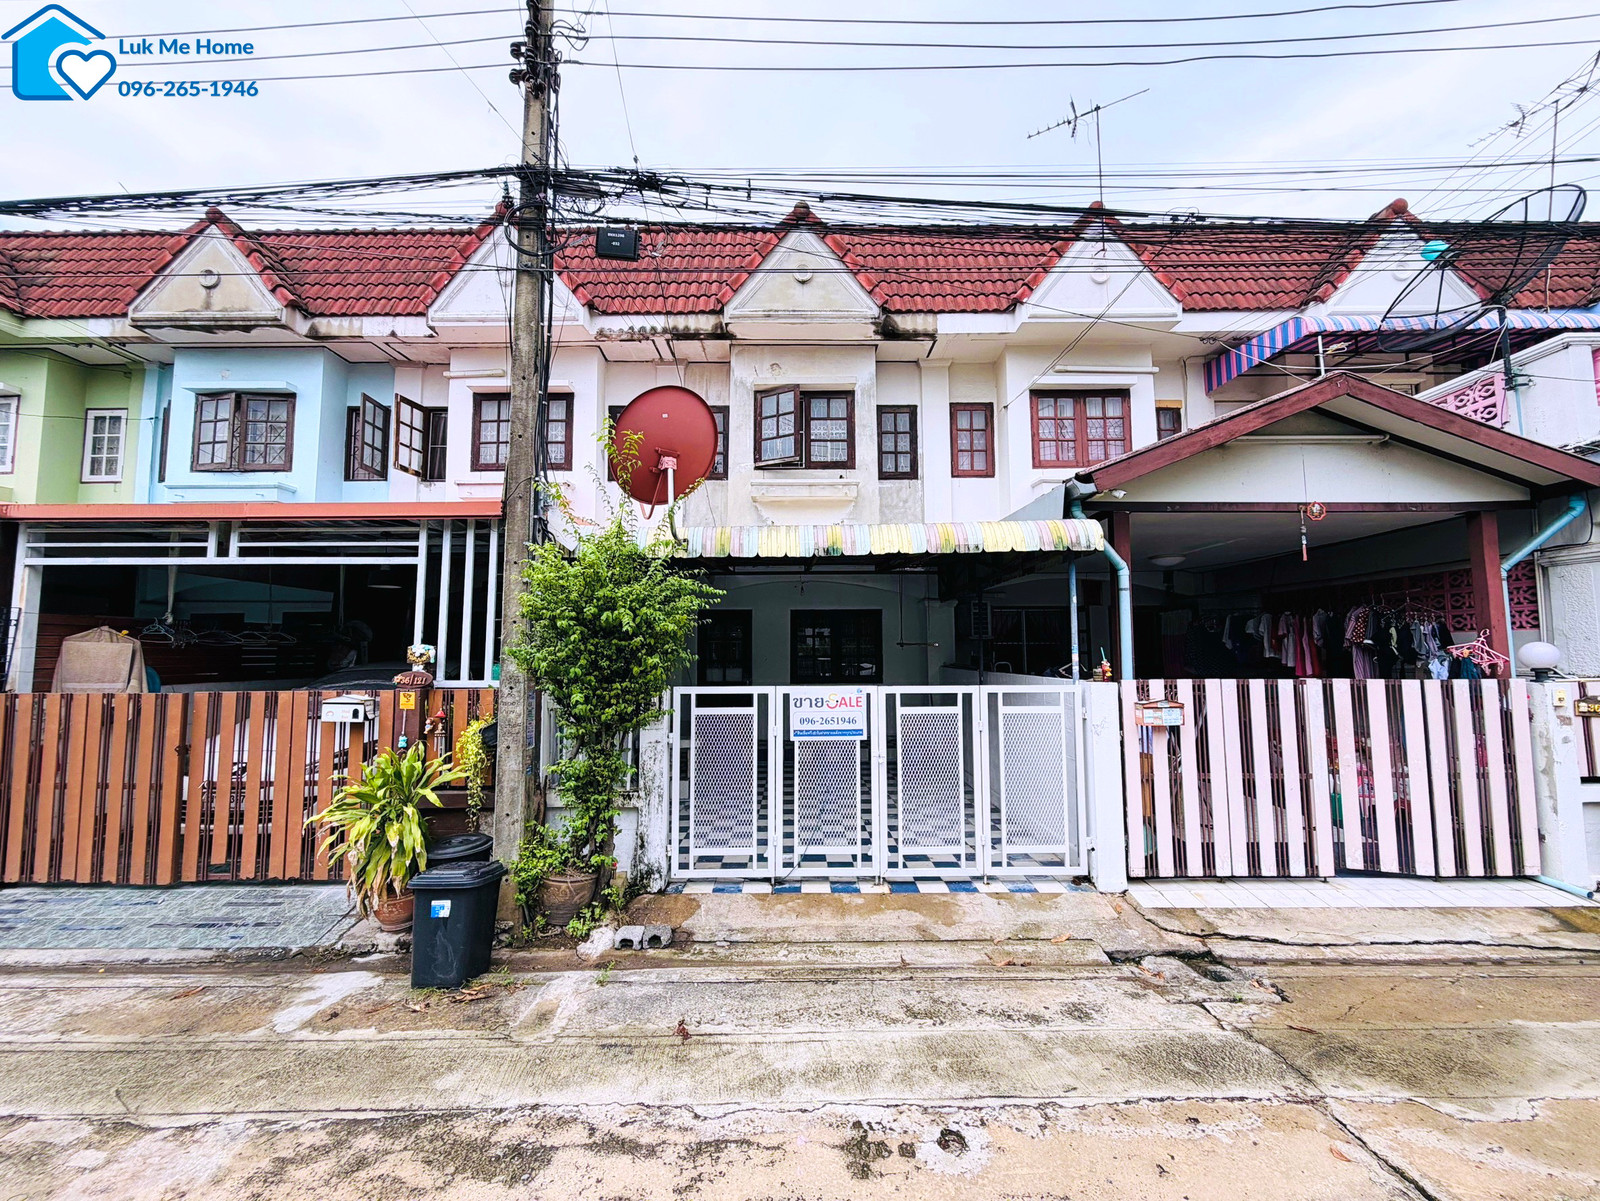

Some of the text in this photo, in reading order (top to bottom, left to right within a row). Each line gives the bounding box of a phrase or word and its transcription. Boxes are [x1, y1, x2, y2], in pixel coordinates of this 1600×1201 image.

[792, 693, 863, 709] ขาย SALE
[799, 716, 857, 726] 096-2651946
